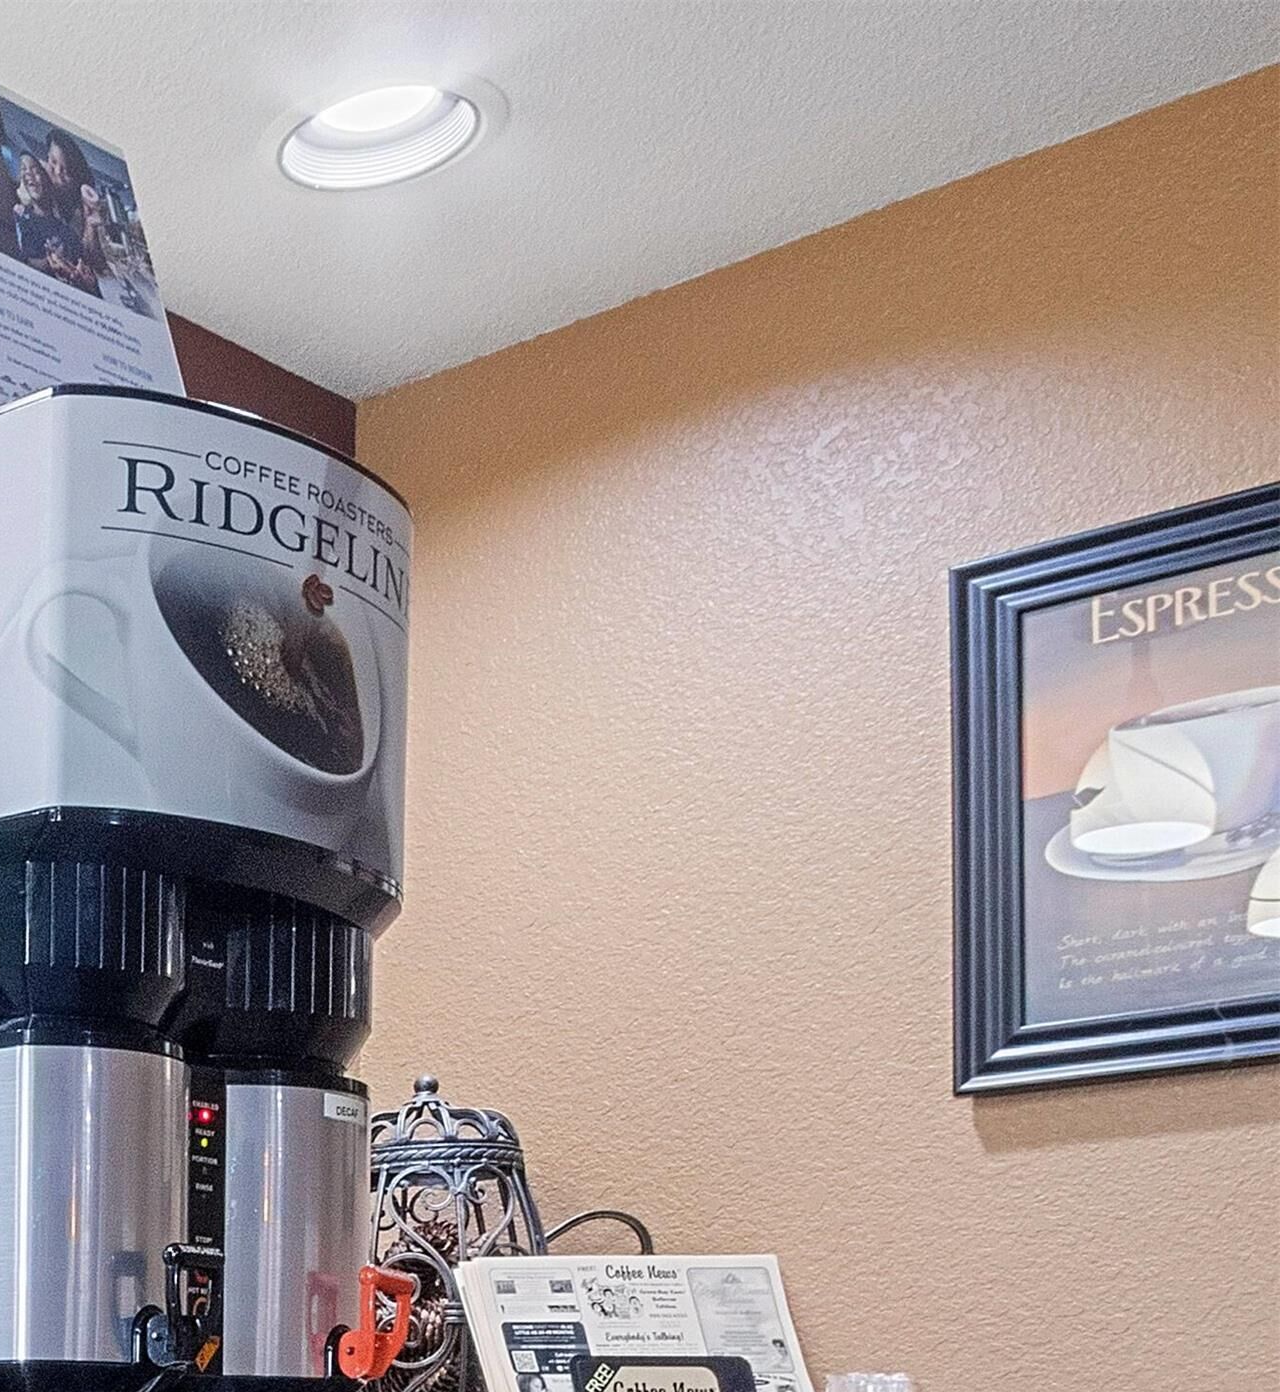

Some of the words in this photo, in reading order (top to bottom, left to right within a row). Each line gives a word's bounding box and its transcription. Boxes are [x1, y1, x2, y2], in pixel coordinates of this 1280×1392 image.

[116, 456, 410, 612] RIDGELIN
[205, 451, 300, 496] COFFEE
[308, 483, 393, 545] ROASTERS
[605, 1265, 643, 1282] Coffee
[647, 1265, 678, 1279] News
